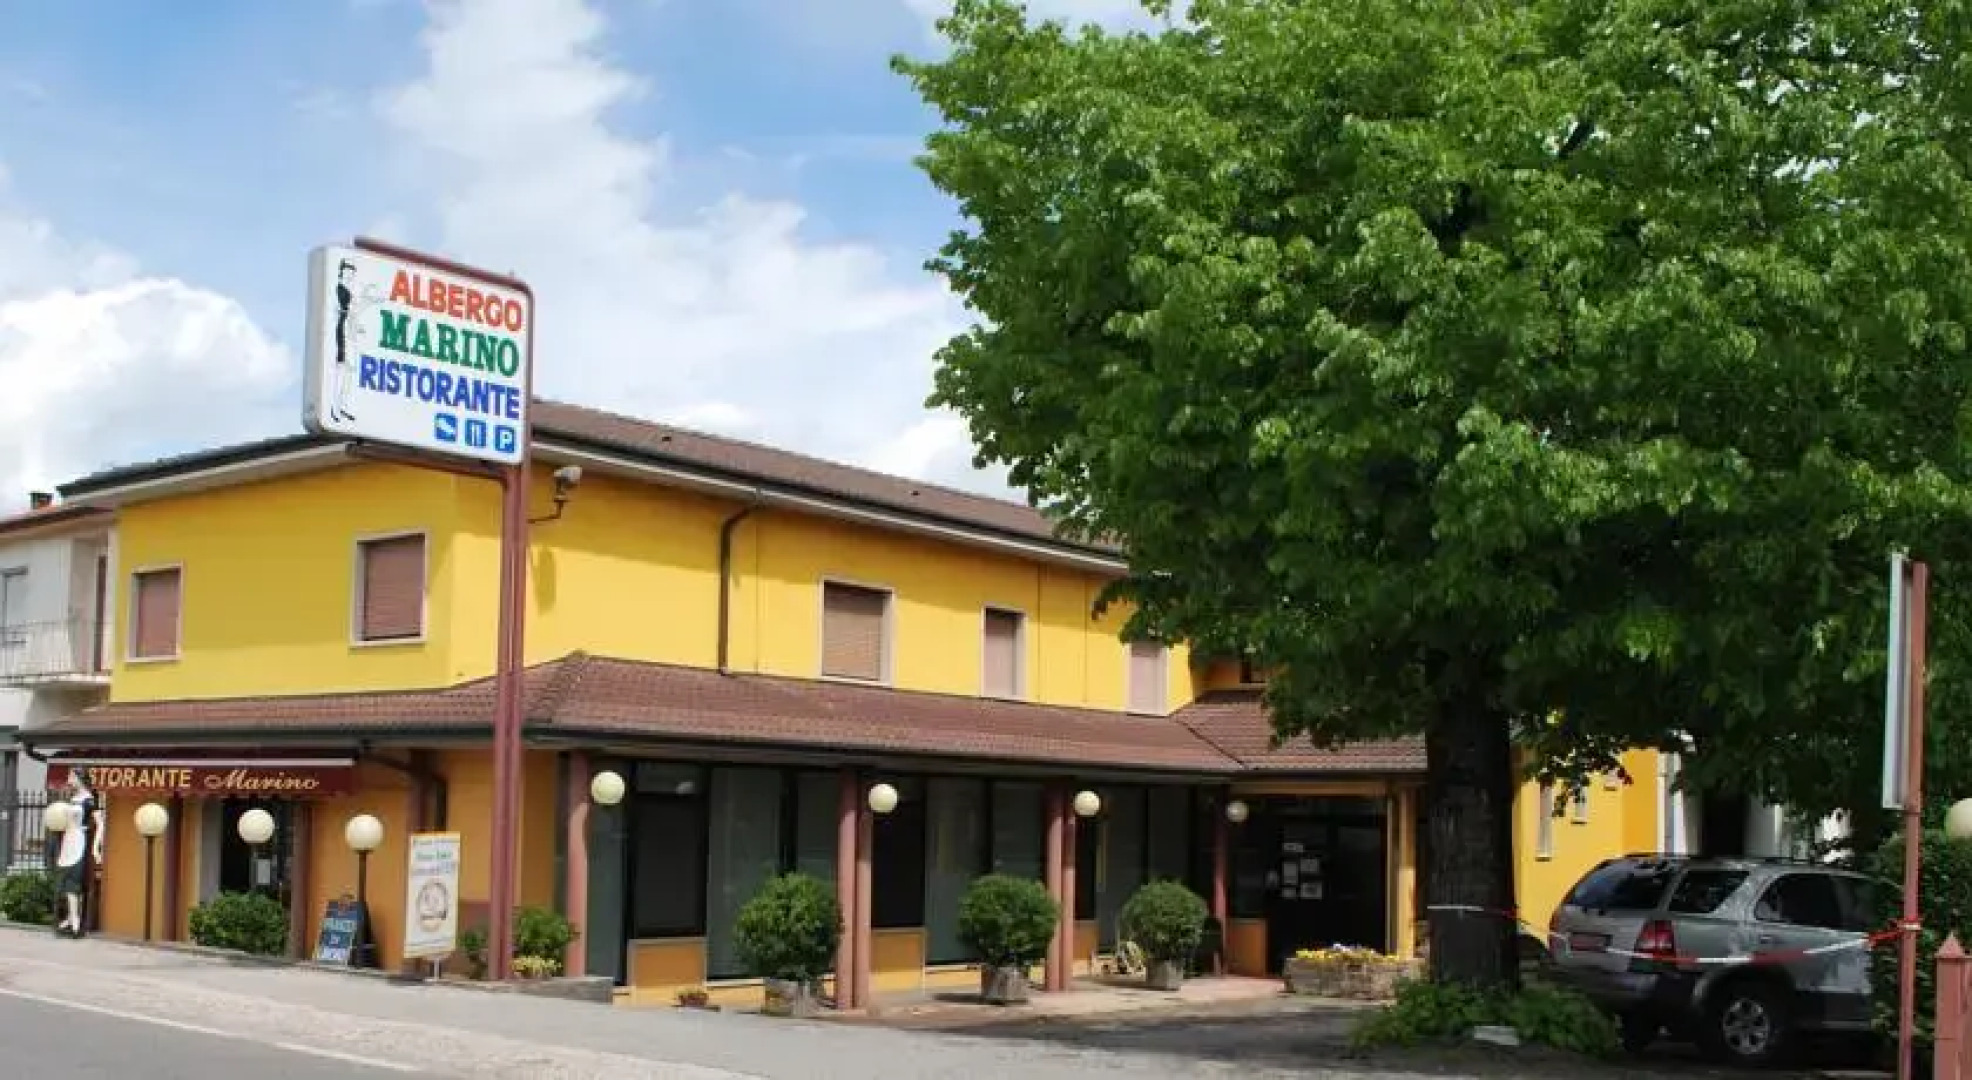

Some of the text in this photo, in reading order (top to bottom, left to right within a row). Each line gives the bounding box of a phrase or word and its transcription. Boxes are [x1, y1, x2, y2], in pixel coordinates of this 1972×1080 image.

[389, 269, 522, 332] ALBERGO
[378, 309, 520, 377] MARINO
[359, 355, 520, 420] RISTORANTE
[67, 767, 320, 790] STORANTE Marino
